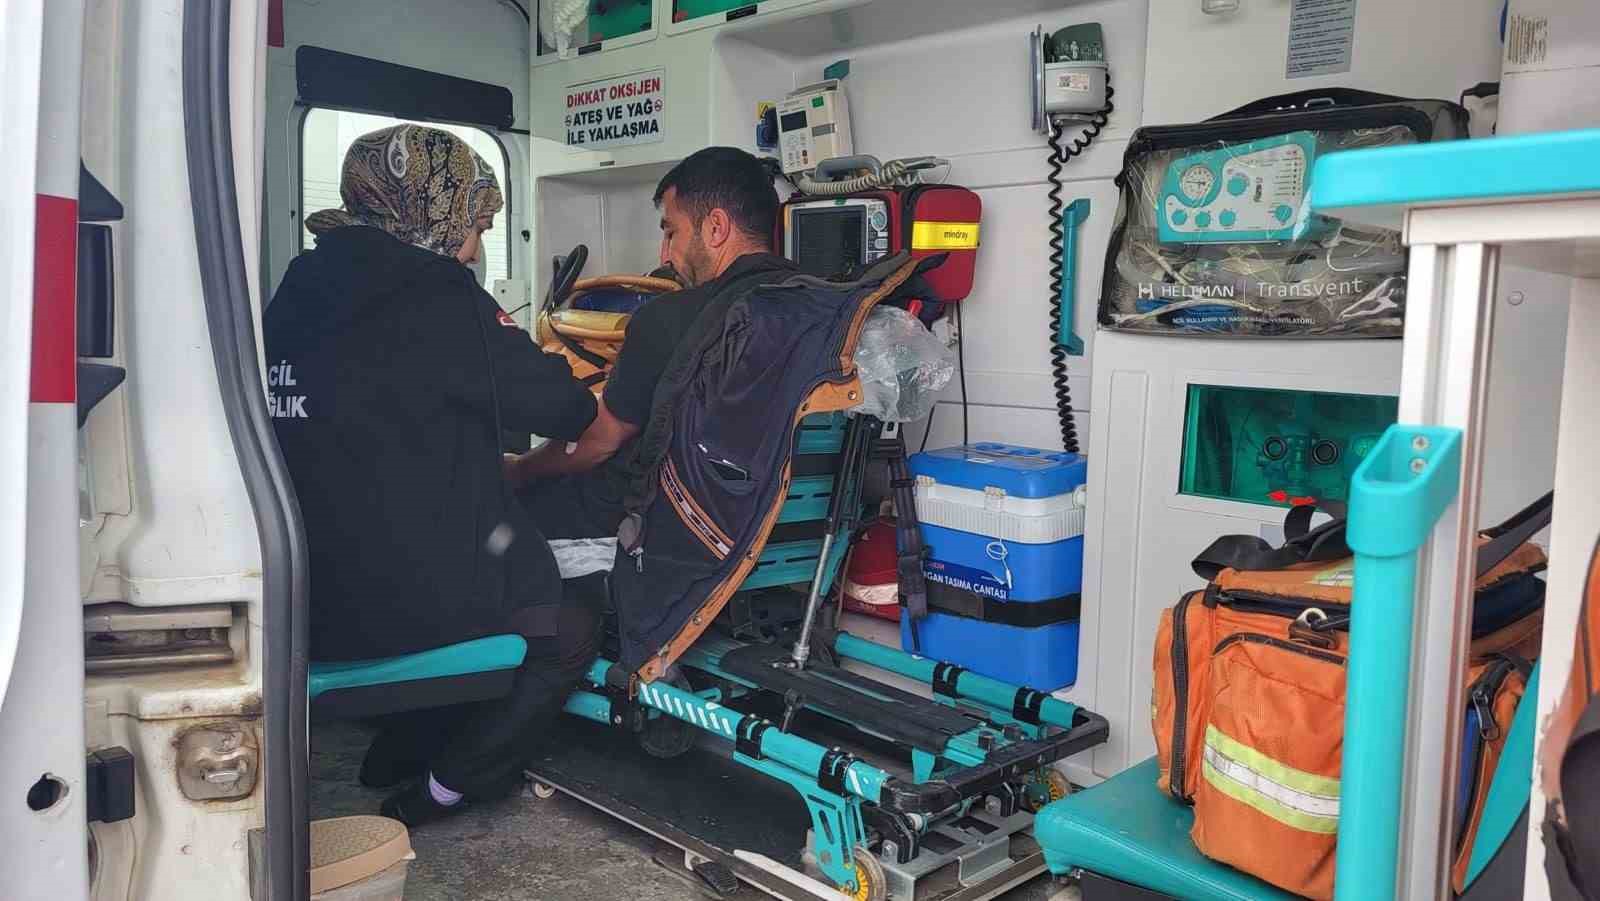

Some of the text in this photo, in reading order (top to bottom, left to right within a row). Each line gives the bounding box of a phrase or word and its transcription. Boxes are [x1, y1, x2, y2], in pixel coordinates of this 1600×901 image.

[566, 77, 661, 108] DİKKAT OKSİJEN
[573, 98, 653, 126] ATEŞ VE YAĞ
[567, 119, 659, 145] İLE YAKLAŞMA
[943, 229, 969, 241] mindray
[1257, 278, 1363, 298] Transvent
